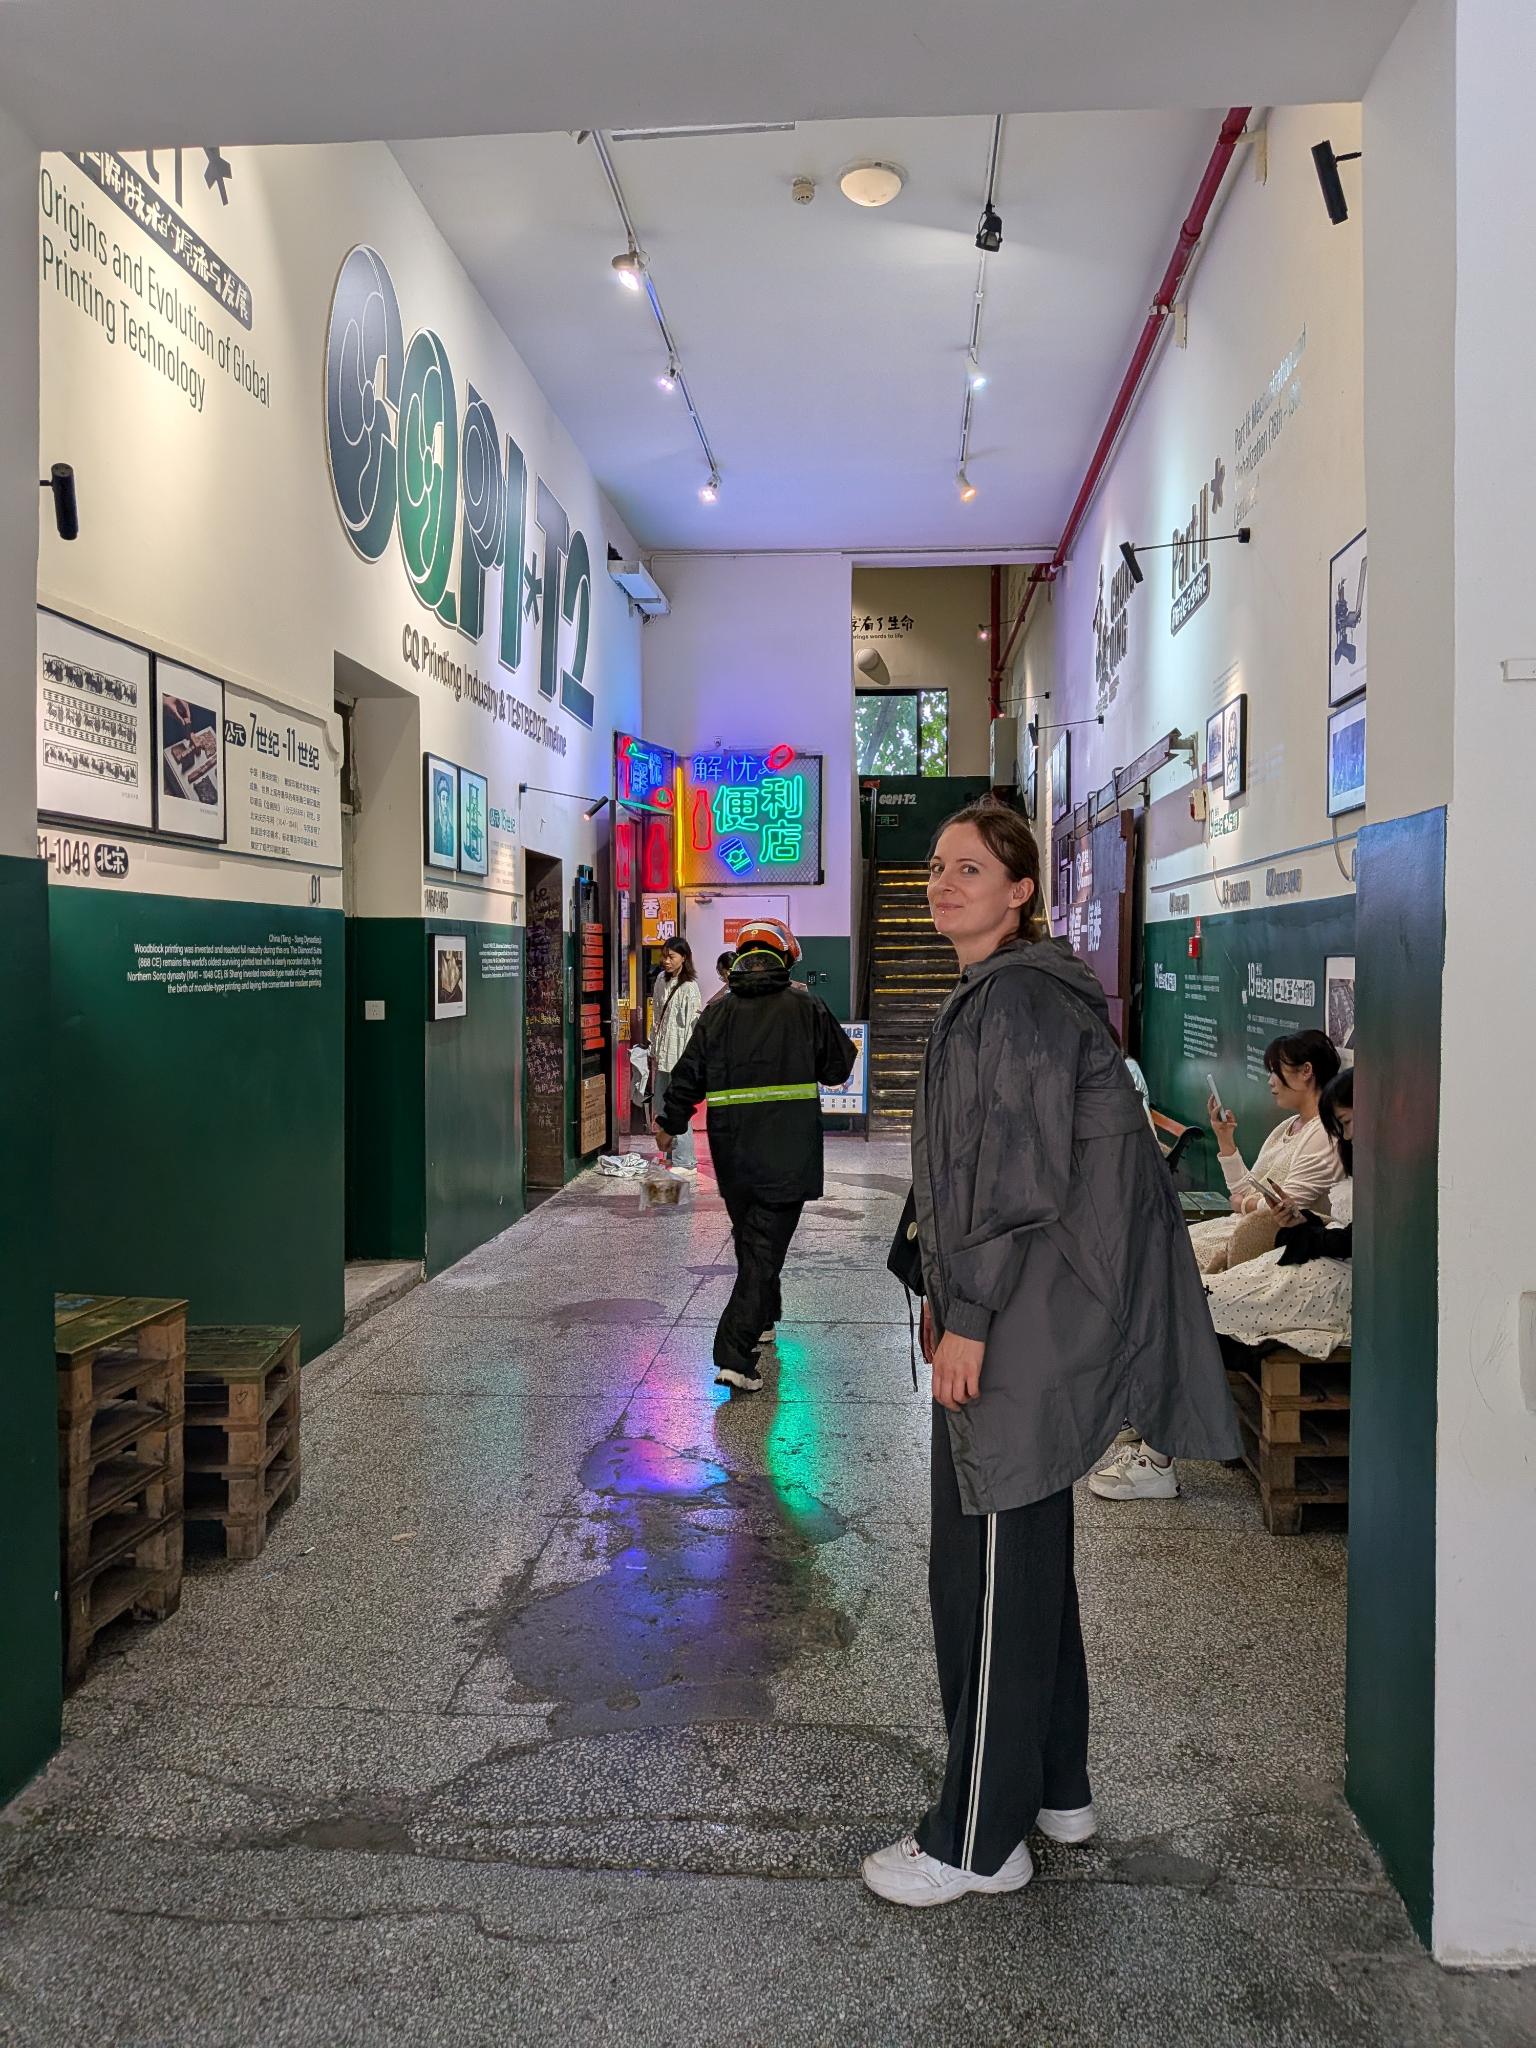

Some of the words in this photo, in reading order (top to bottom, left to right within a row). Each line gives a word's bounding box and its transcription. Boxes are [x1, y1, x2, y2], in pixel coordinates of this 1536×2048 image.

[41, 168, 108, 267] Origins
[112, 243, 143, 299] and
[148, 266, 214, 361] Evolution
[218, 336, 231, 374] of
[233, 344, 270, 408] Global
[43, 234, 116, 345] Printing
[120, 299, 206, 413] Technology
[1172, 503, 1199, 601] Part
[402, 623, 420, 673] CQ
[421, 635, 462, 702] Printing
[463, 663, 499, 724] Industry
[499, 689, 506, 722] &
[225, 721, 245, 745] 公元
[693, 754, 758, 783] 解忧
[97, 846, 127, 875] 北宋
[310, 873, 322, 904] 01
[133, 943, 164, 953] Woodblock
[164, 944, 184, 955] printing
[194, 945, 214, 953] invented
[214, 945, 223, 953] and
[223, 945, 240, 953] reached
[137, 957, 151, 968] (868
[151, 957, 162, 968] CE)
[162, 957, 182, 967] remains
[182, 957, 190, 966] the
[207, 957, 221, 966] oldest
[221, 957, 240, 967] surviving
[127, 971, 152, 981] Northern
[152, 971, 166, 982] Song
[166, 971, 186, 981] dynasty
[186, 970, 198, 981] (1041
[228, 969, 242, 979] Sheng
[167, 984, 176, 993] the
[176, 984, 188, 993] birth
[188, 983, 194, 992] of
[224, 981, 241, 992] printing
[241, 981, 249, 990] and
